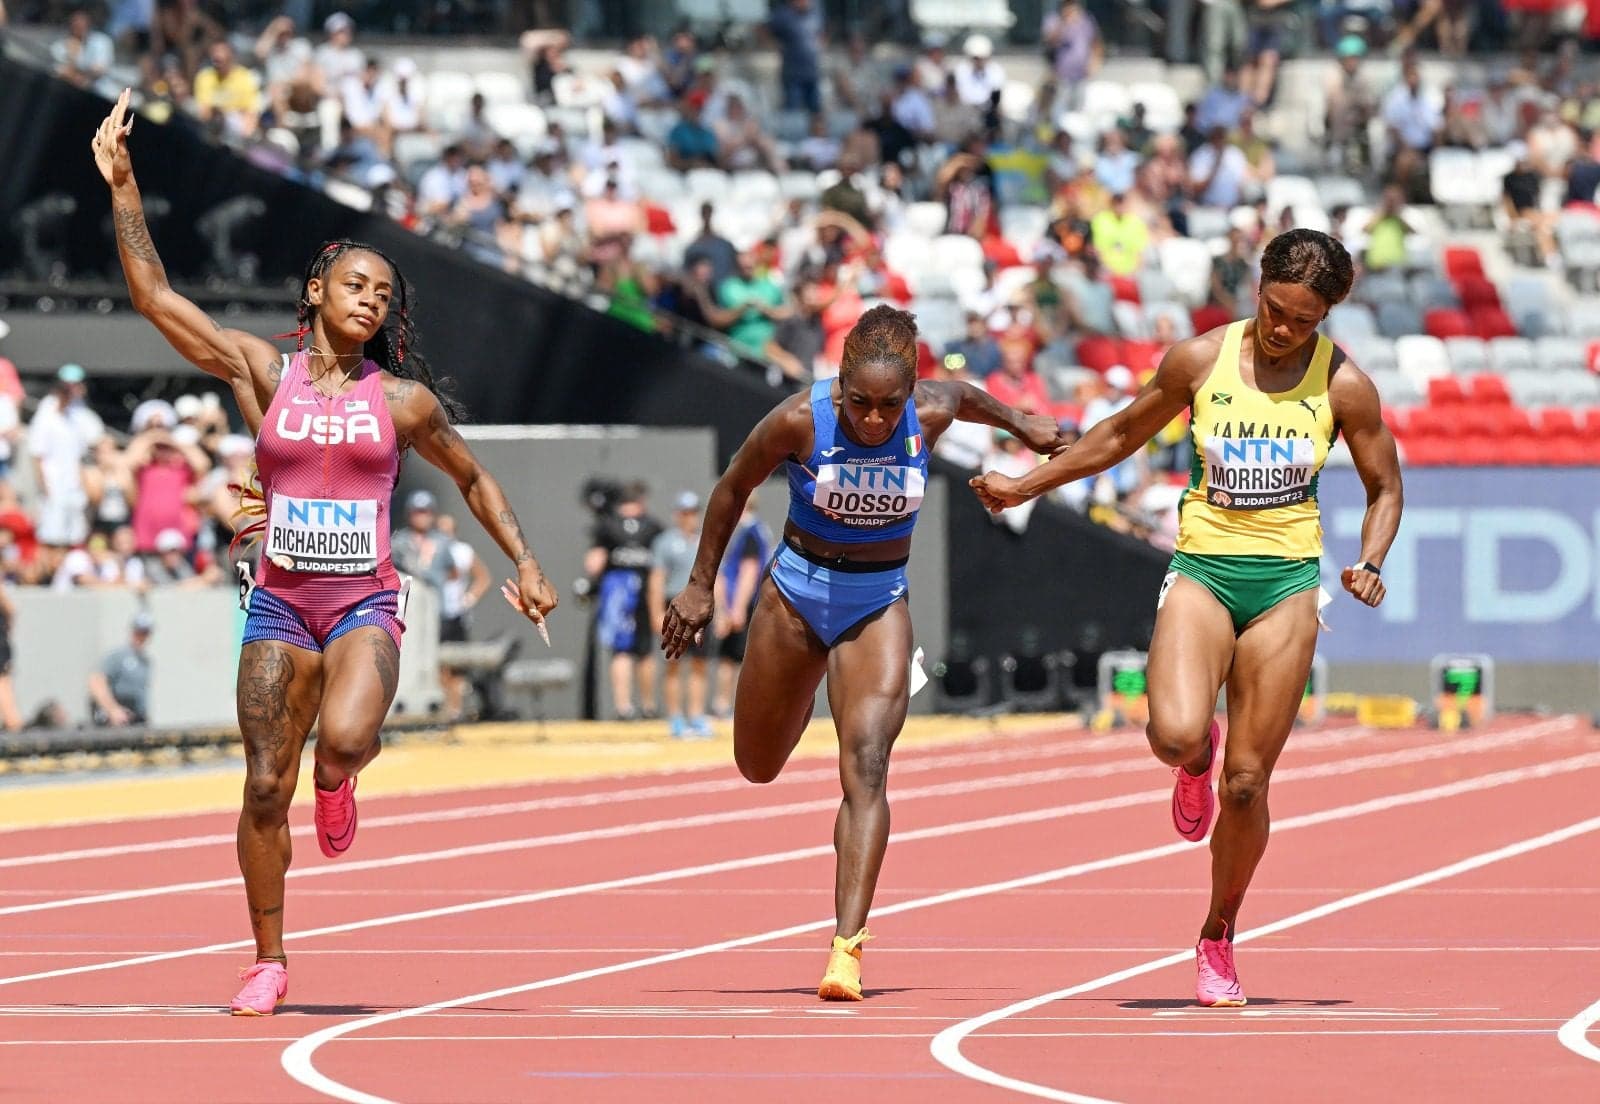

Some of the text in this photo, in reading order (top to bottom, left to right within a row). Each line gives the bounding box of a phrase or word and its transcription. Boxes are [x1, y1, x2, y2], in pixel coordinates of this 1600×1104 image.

[276, 408, 381, 445] USA
[1223, 439, 1294, 464] NTN
[839, 466, 906, 491] NTN
[1211, 464, 1308, 490] MORRISON
[287, 500, 357, 528] NTN
[827, 491, 908, 513] DOSSO
[272, 526, 371, 555] RICHARDSON
[1332, 507, 1600, 621] TD
